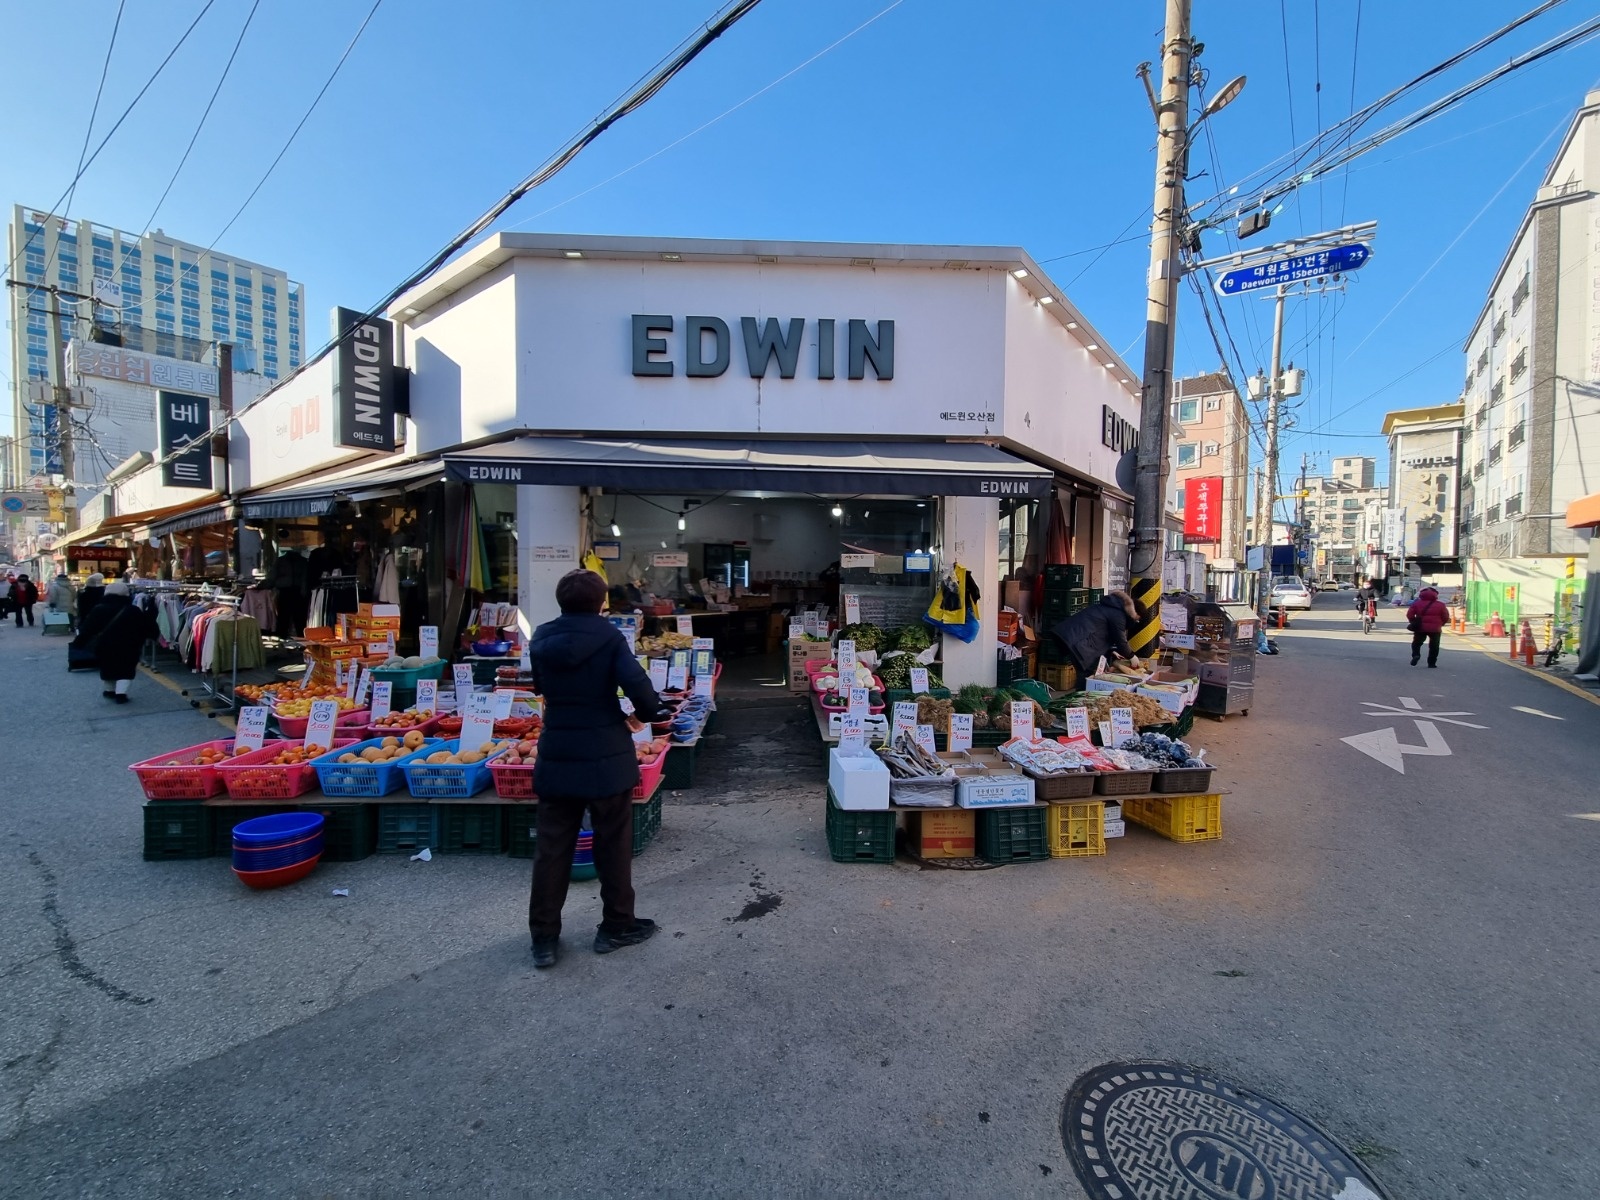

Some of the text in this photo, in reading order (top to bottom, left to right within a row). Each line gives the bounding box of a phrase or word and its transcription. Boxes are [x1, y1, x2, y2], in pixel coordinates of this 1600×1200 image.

[1349, 251, 1363, 262] 23
[1223, 278, 1234, 288] 19
[1241, 262, 1342, 290] Daewon-ro 15beon-gil
[631, 314, 895, 381] EDWIN
[153, 364, 217, 394] 원룸텔
[353, 321, 381, 425] EDWIN
[939, 411, 995, 422] 에드윈 오산점
[171, 403, 201, 481] 베스트
[353, 431, 383, 444] 에드윈
[469, 466, 522, 480] EDWIN
[980, 481, 1029, 494] EDWIN
